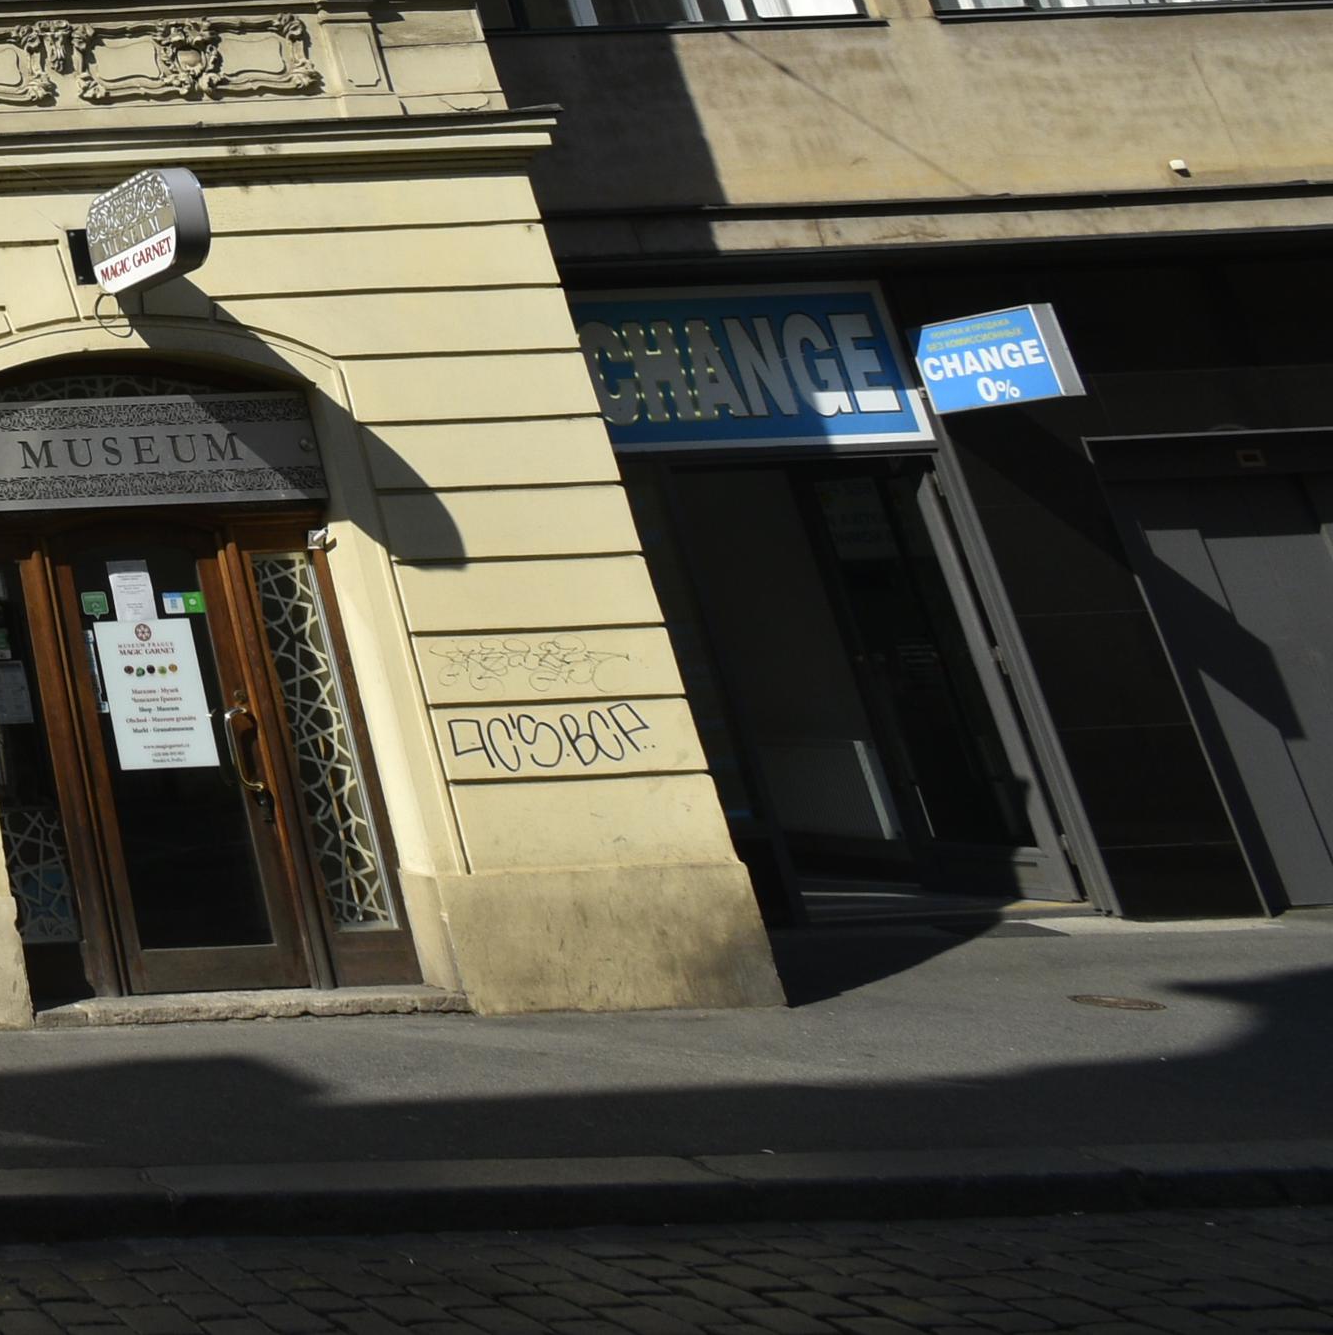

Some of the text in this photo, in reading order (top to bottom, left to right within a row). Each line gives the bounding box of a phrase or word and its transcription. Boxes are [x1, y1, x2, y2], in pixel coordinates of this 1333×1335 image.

[100, 236, 173, 282] MAGIC GARNET
[577, 313, 902, 426] CHANGE
[923, 339, 1046, 381] CHANGE
[976, 376, 1021, 402] 0%
[17, 433, 244, 469] MUSEUM
[119, 647, 175, 656] MAGIC GARNET
